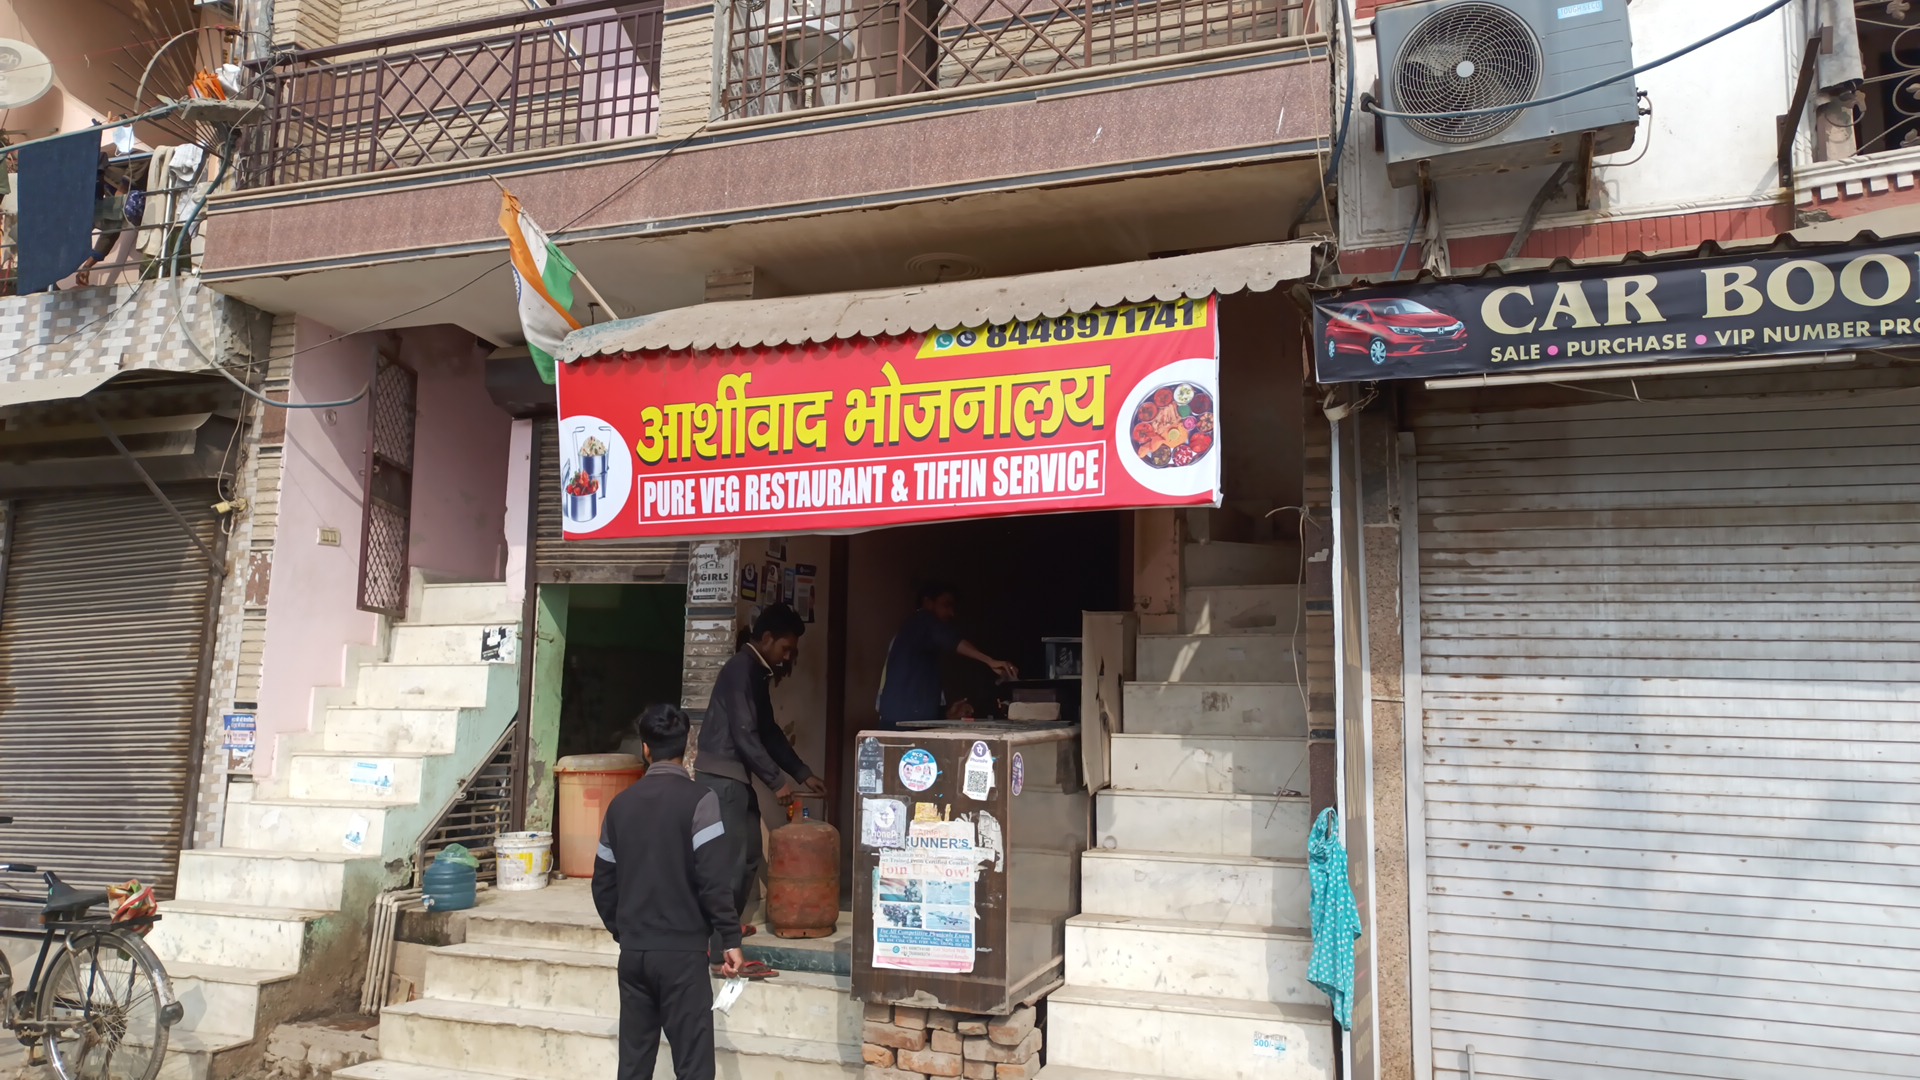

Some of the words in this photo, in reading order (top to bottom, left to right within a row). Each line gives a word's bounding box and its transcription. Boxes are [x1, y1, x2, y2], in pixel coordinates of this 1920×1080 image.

[1481, 274, 1667, 334] CAR
[1701, 251, 1920, 318] BOO
[986, 300, 1194, 348] 8448971741
[1490, 344, 1541, 362] SALE
[1567, 333, 1687, 357] PURCHASE
[1714, 328, 1755, 346] VIP
[1763, 320, 1871, 344] NUMBER
[844, 361, 1111, 446] भोजनालय
[643, 478, 696, 517] PURE
[699, 475, 740, 514] VEG
[745, 464, 887, 511] RESTAURANT
[891, 469, 909, 503] &
[914, 457, 987, 502] TIFFIN
[992, 449, 1099, 497] SERVICE
[700, 573, 729, 581] GIRLS
[882, 863, 908, 875] Join
